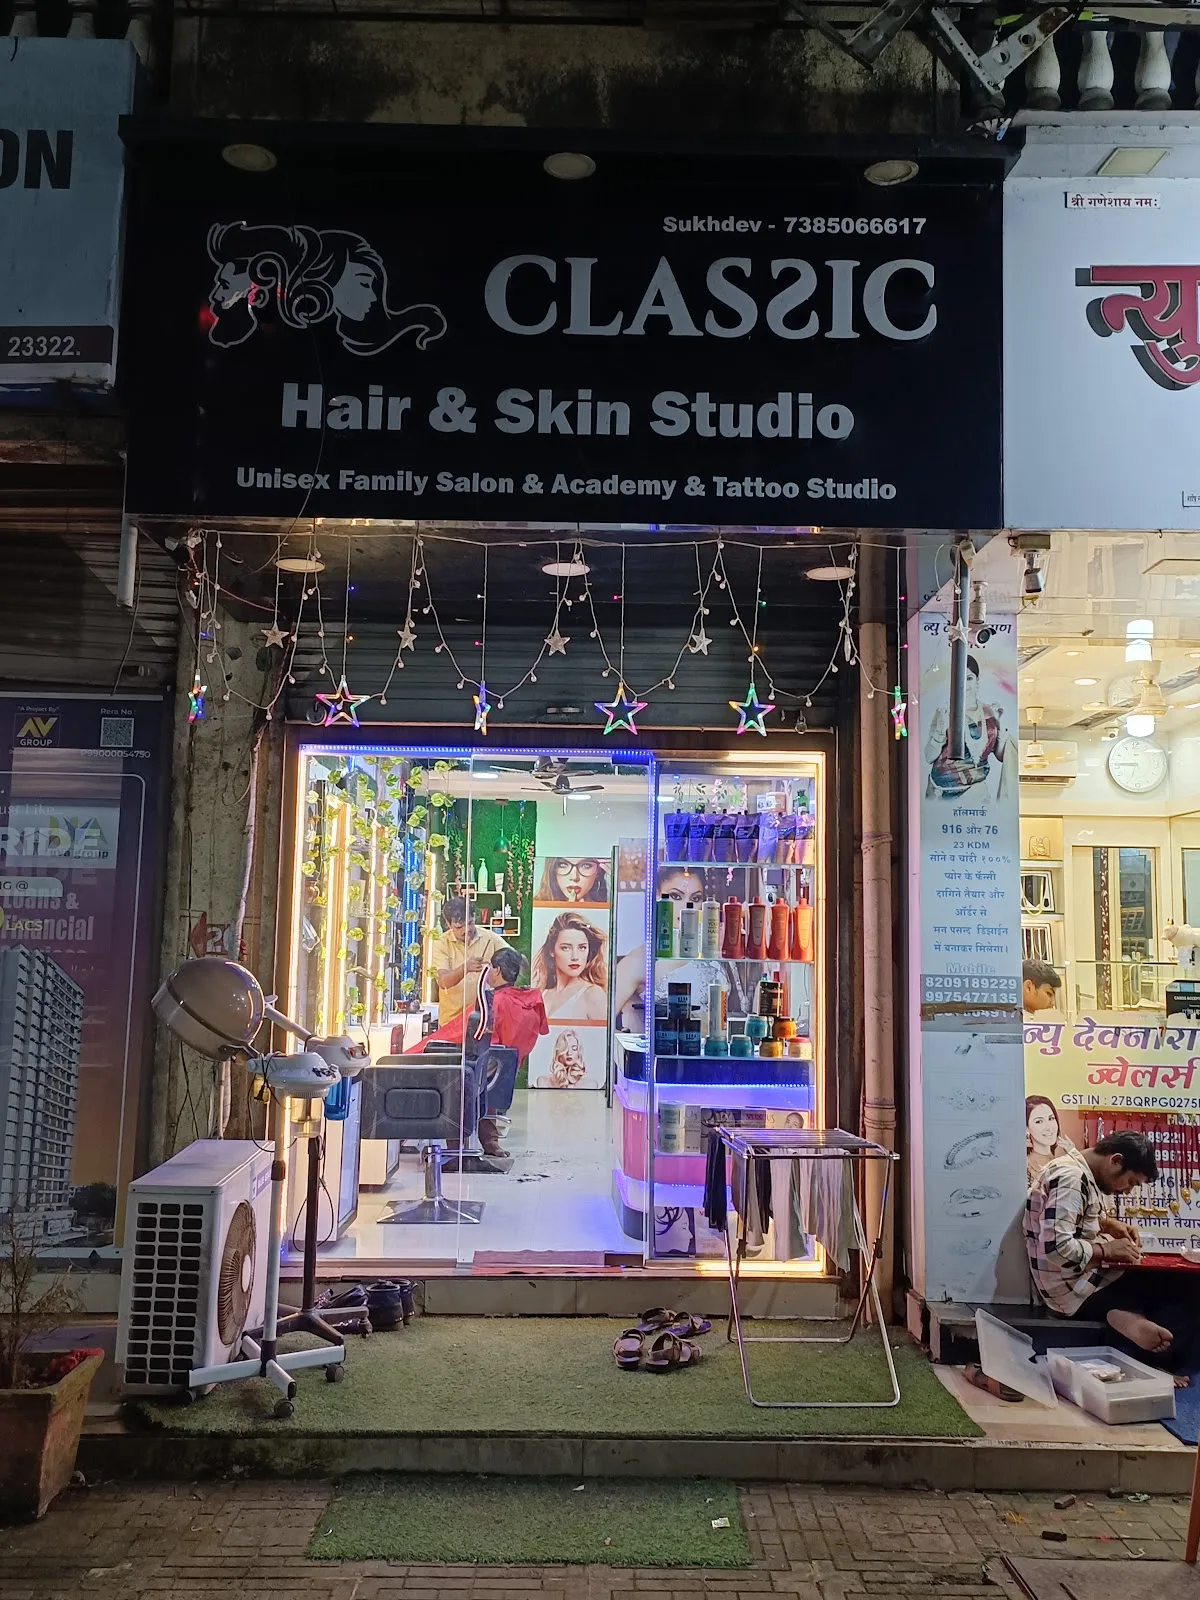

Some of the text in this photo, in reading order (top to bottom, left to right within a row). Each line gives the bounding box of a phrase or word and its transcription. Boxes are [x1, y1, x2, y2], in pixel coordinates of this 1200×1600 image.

[1071, 194, 1084, 206] श्री
[1088, 194, 1131, 207] गणेशाय
[663, 216, 762, 232] Sukhdev
[784, 217, 927, 234] 7385066617
[484, 255, 937, 340] CLASSIC
[282, 382, 854, 439] Hair & Skin Studio
[237, 467, 896, 500] Unisex Family Salon & Academy & Tattoo Studio
[942, 823, 998, 835] 916 और 76
[66, 892, 79, 909] &
[946, 962, 995, 974] Mobile
[925, 977, 1017, 989] 8209189229
[925, 992, 1017, 1003] 9975477135
[1023, 1017, 1200, 1055] न्यु देवनारा
[1061, 1094, 1083, 1105] GST
[1087, 1095, 1099, 1105] IN
